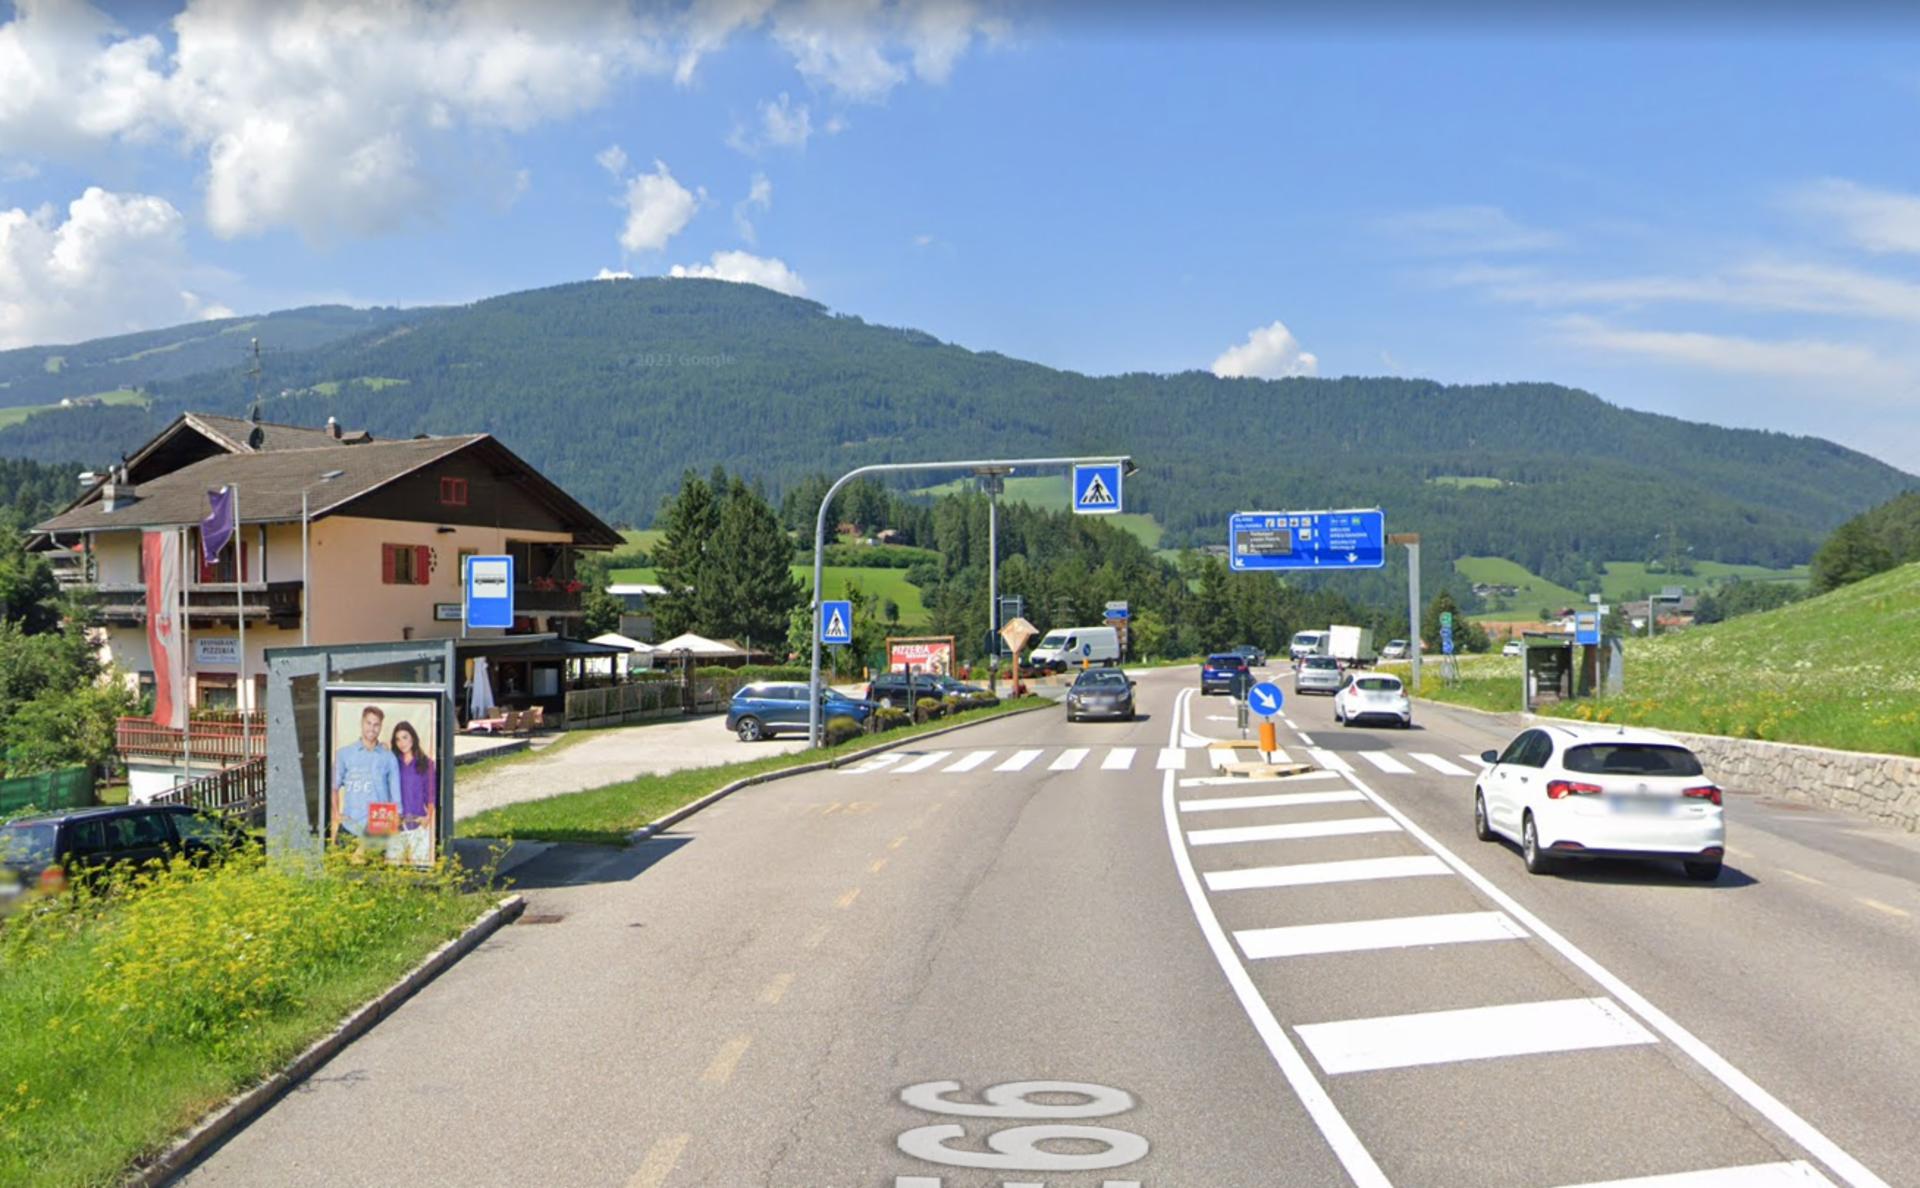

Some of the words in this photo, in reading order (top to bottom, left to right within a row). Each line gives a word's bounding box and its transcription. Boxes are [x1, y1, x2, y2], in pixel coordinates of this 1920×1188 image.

[202, 647, 235, 655] PIZZERIA
[892, 645, 929, 656] PIZZERIA
[896, 1080, 1150, 1188] 66
